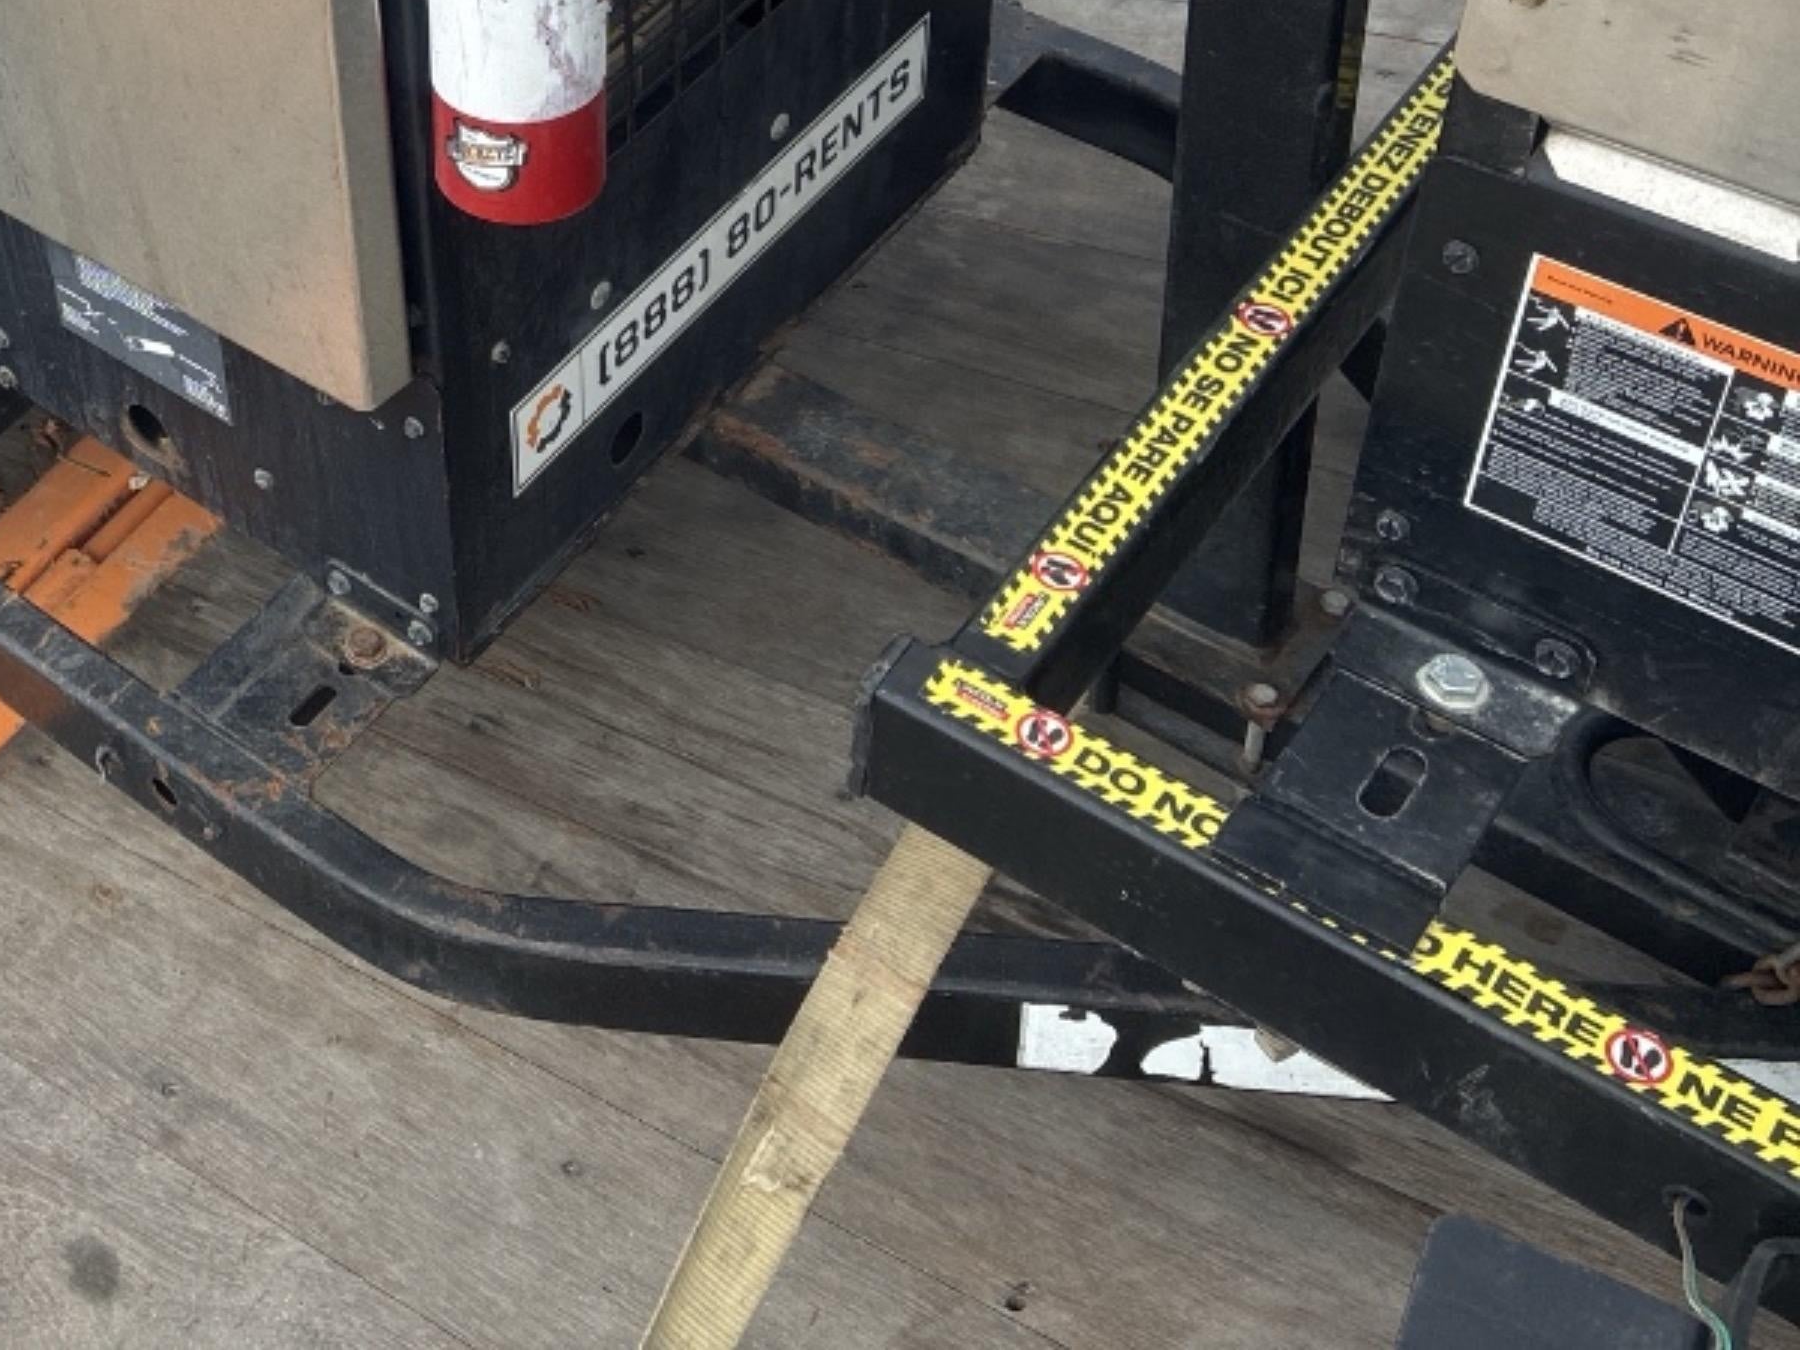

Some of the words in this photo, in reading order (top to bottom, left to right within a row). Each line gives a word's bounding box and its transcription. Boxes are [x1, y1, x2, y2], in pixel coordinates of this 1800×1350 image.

[726, 59, 911, 259] 80-RENTS
[1302, 172, 1390, 270] DEBOUT
[1270, 267, 1313, 303] ICI
[1215, 333, 1260, 373] NO
[1702, 333, 1800, 384] WARNIN
[1181, 374, 1224, 413] SE
[1122, 411, 1196, 486] PARE
[1074, 747, 1146, 795] DO
[1153, 791, 1222, 839] NO
[1452, 947, 1605, 1048] HERE
[1677, 1070, 1762, 1131] NE
